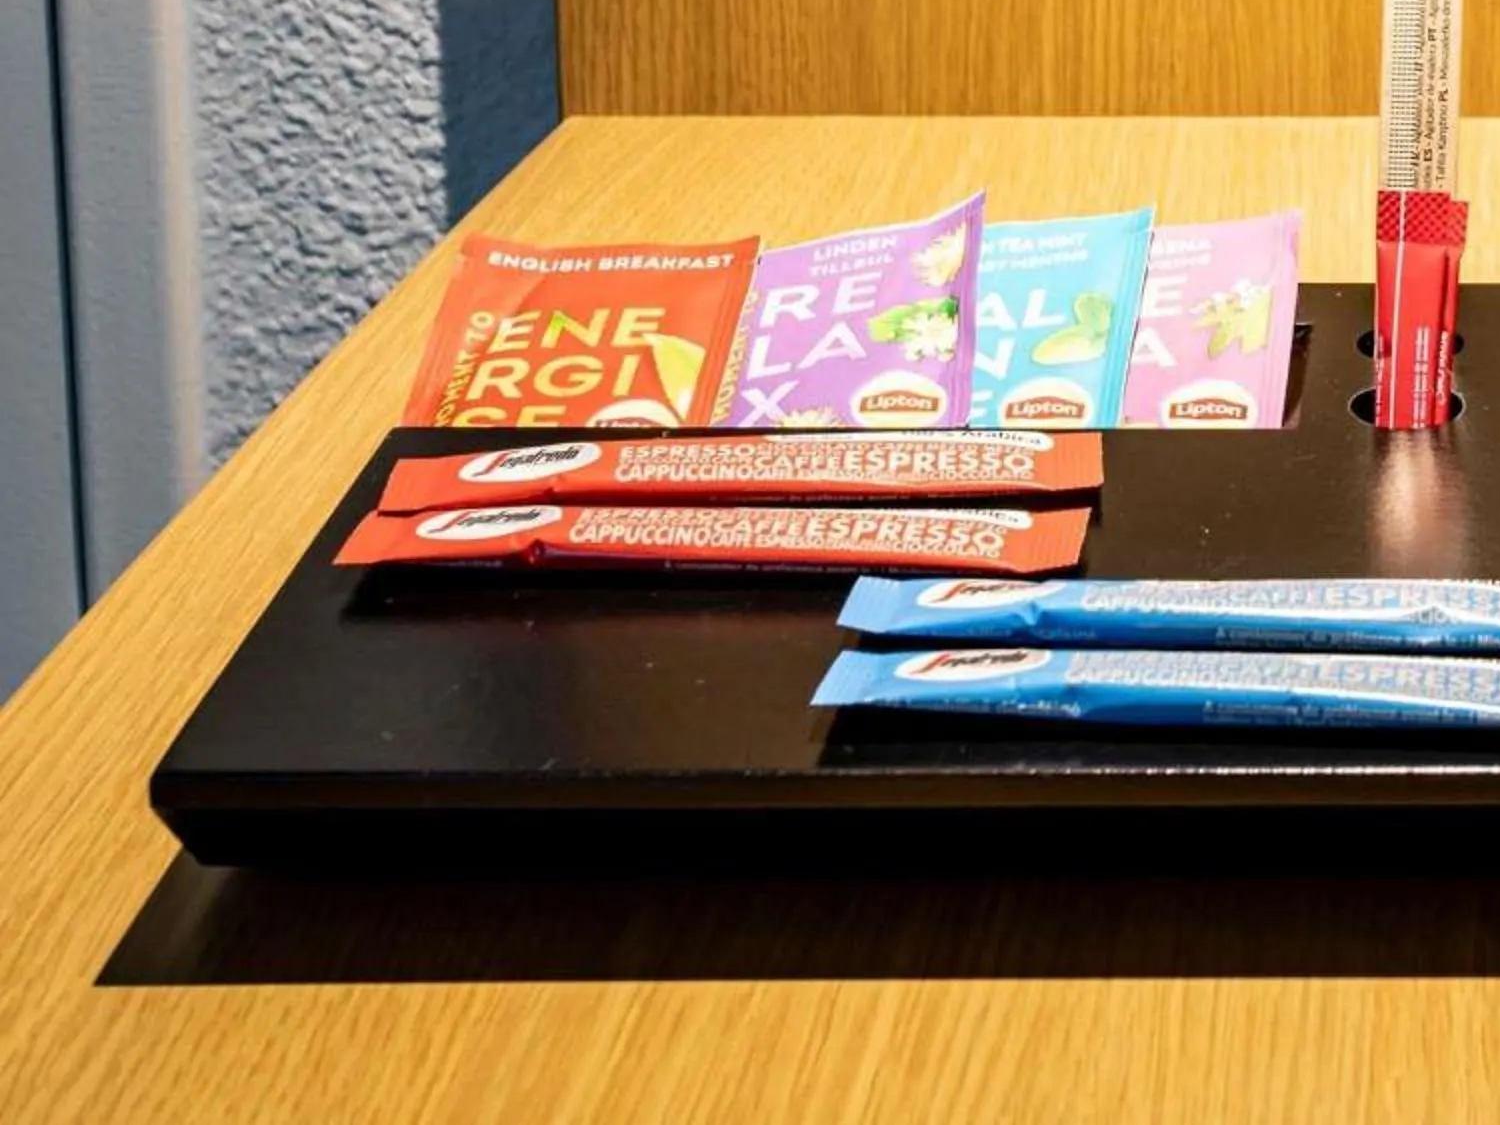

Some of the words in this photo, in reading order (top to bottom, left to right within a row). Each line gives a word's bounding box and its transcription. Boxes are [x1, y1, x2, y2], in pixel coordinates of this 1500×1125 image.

[813, 236, 898, 262] LINDEN
[486, 250, 592, 274] ENGLISH
[597, 252, 736, 272] BREAKFAST
[759, 271, 882, 328] RE
[487, 307, 667, 355] ENE
[746, 321, 868, 381] LA
[464, 355, 641, 402] RGI
[737, 379, 800, 427] X
[866, 395, 933, 412] Lipton
[1013, 401, 1078, 418] Lipton
[1175, 402, 1242, 418] Lipton
[619, 443, 756, 460] ESPRESSO
[843, 450, 1035, 473] ESPRESSO
[614, 463, 753, 483] CAPPUCCINO
[569, 522, 712, 547] CAPPUCCINO
[806, 518, 1004, 553] ESPRESSO
